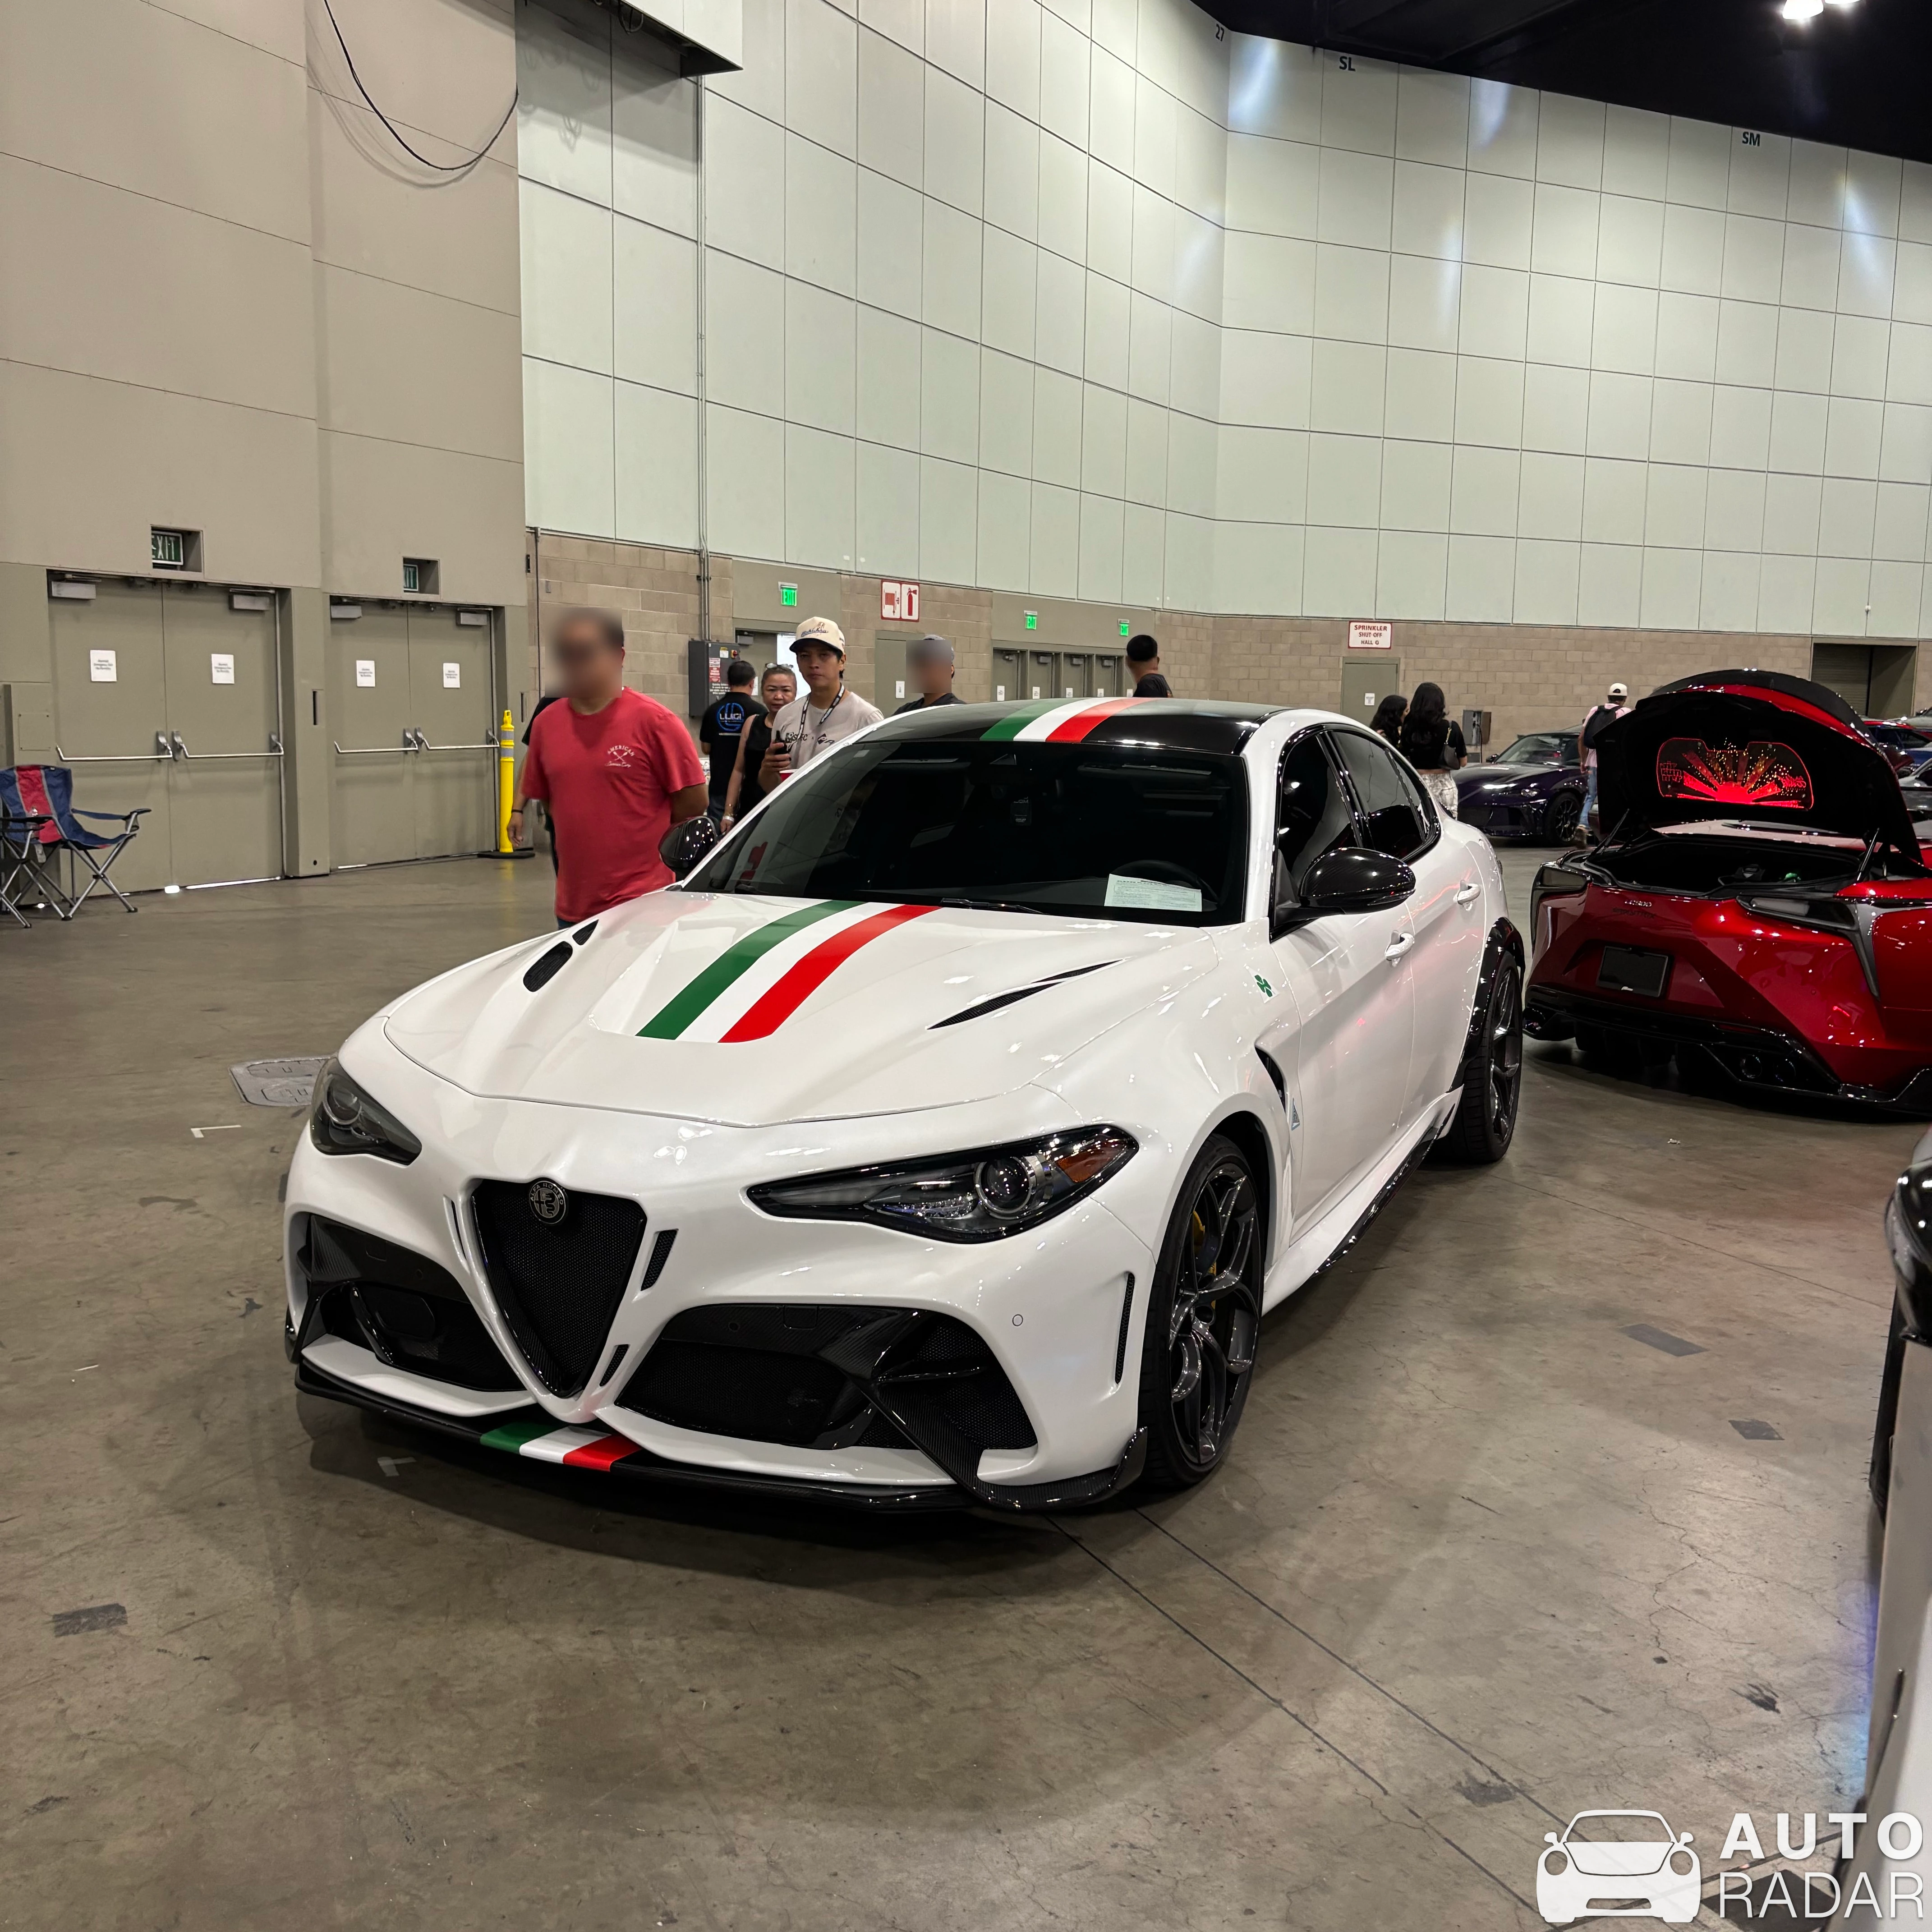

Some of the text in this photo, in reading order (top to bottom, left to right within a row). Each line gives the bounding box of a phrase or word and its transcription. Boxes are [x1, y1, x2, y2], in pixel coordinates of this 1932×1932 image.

[1339, 56, 1356, 71] SL
[1742, 131, 1761, 147] SM
[530, 1182, 564, 1205] ALFA ROMEO
